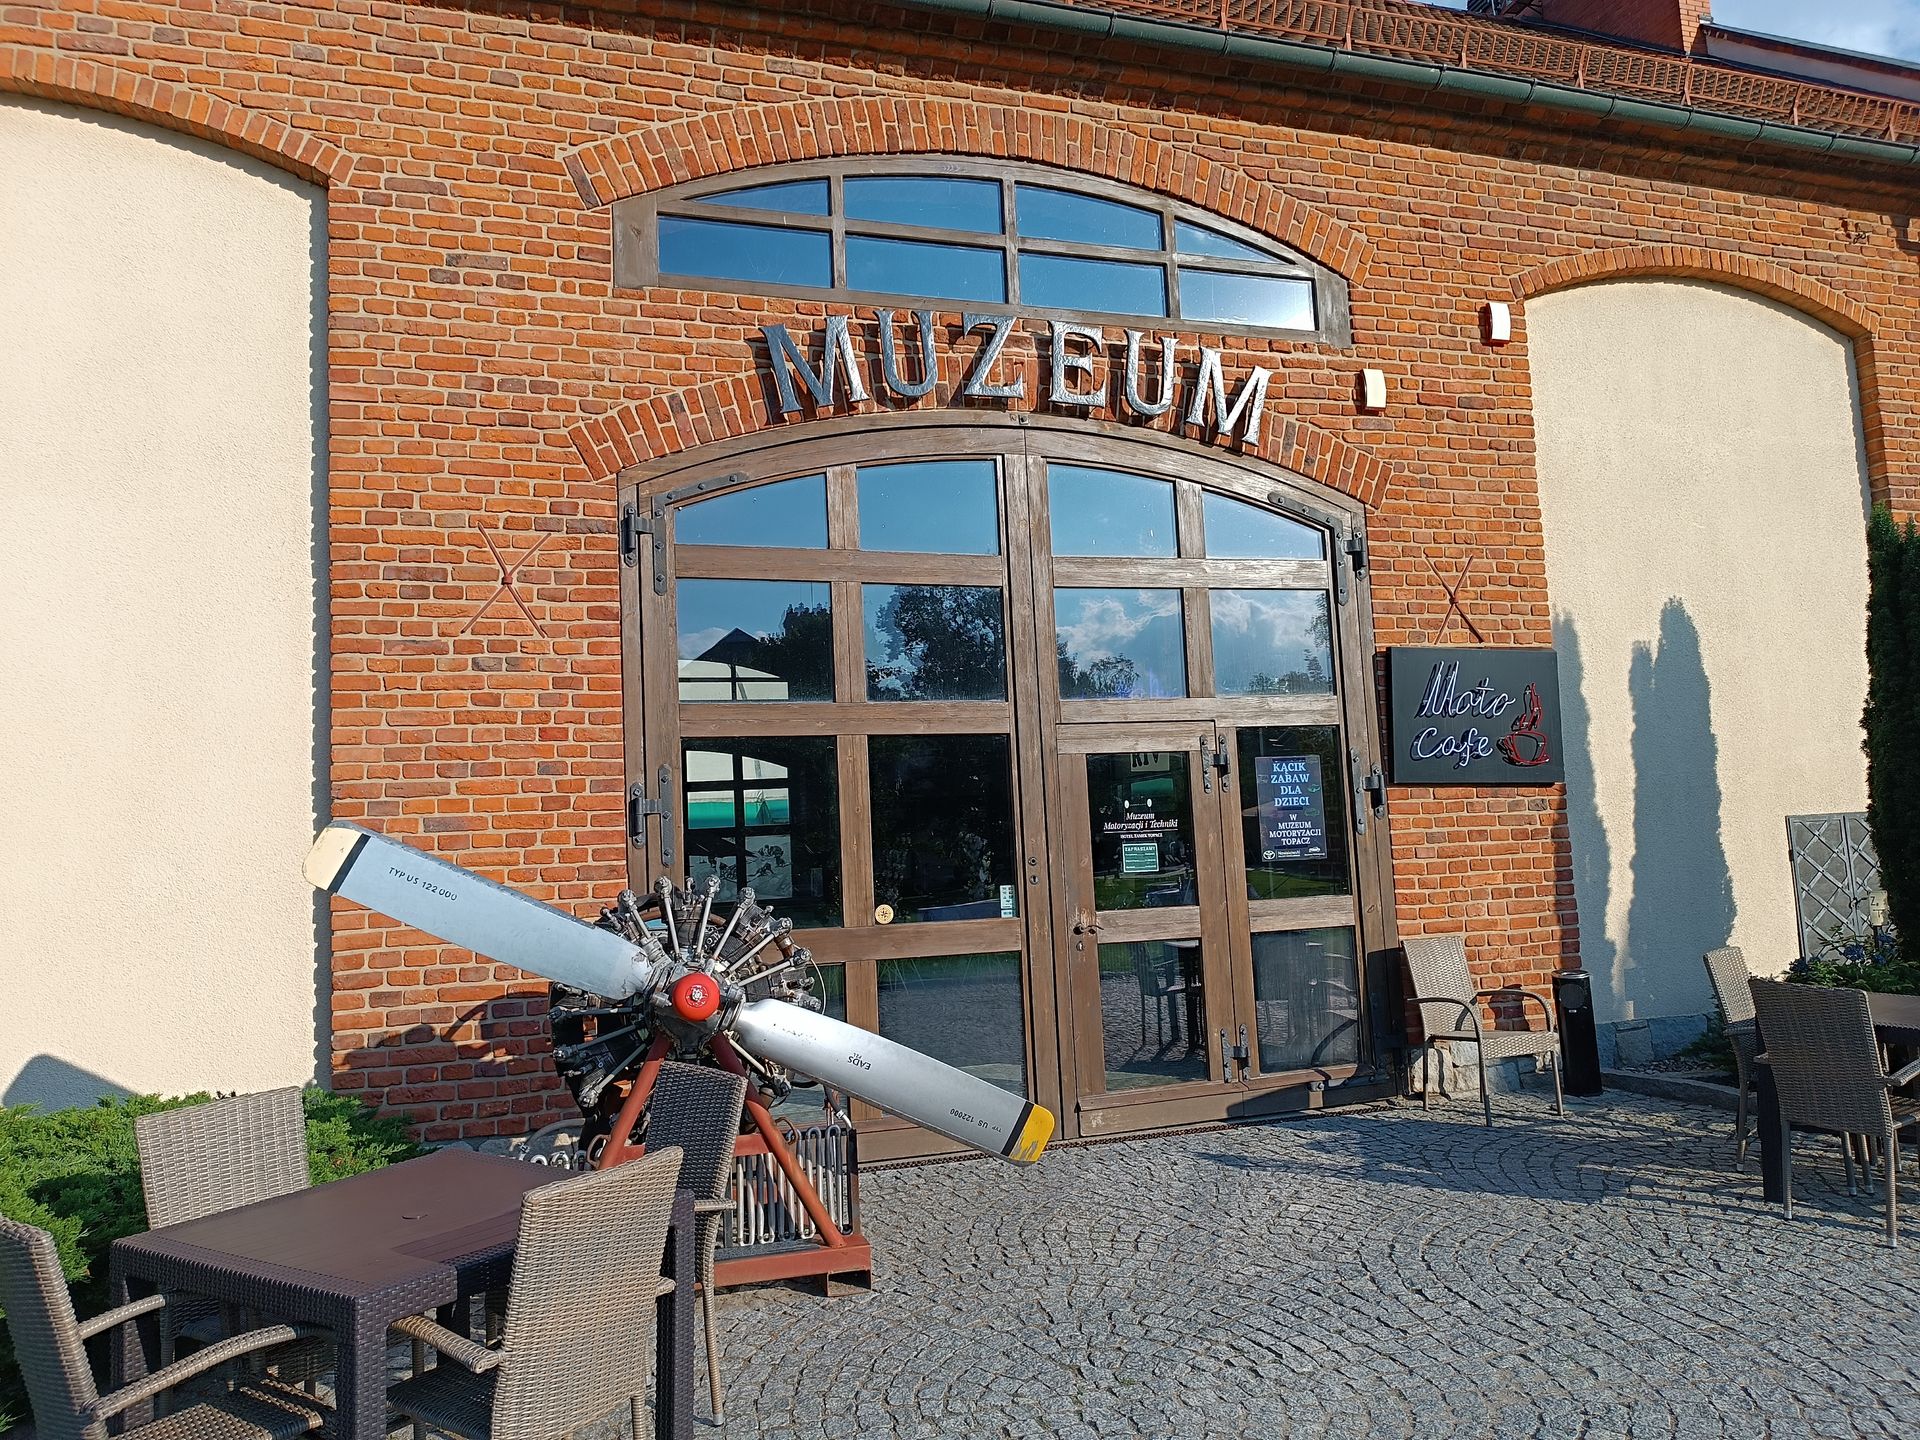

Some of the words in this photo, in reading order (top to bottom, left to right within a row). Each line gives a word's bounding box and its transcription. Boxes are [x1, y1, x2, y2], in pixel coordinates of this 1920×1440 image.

[759, 309, 1273, 447] MUZEUM
[1421, 660, 1516, 717] Moto
[1416, 727, 1494, 767] Cafe
[1272, 762, 1307, 774] KĄCIK
[1270, 774, 1310, 784] ZABAW
[1280, 785, 1303, 795] DLA
[1274, 796, 1310, 807] DZIECI
[1125, 812, 1155, 821] Muzeum
[1289, 813, 1298, 821] W
[1103, 820, 1144, 831] Motoryzacji
[1149, 818, 1178, 829] Techniki
[1278, 821, 1312, 830] MUZEUM
[1269, 828, 1322, 838] MOTORYZACJI
[1281, 837, 1311, 846] TOPACZ
[388, 866, 406, 878] TYP
[406, 874, 420, 885] US
[847, 1055, 872, 1071] EADS
[949, 1108, 975, 1123] 122000
[977, 1119, 989, 1129] US
